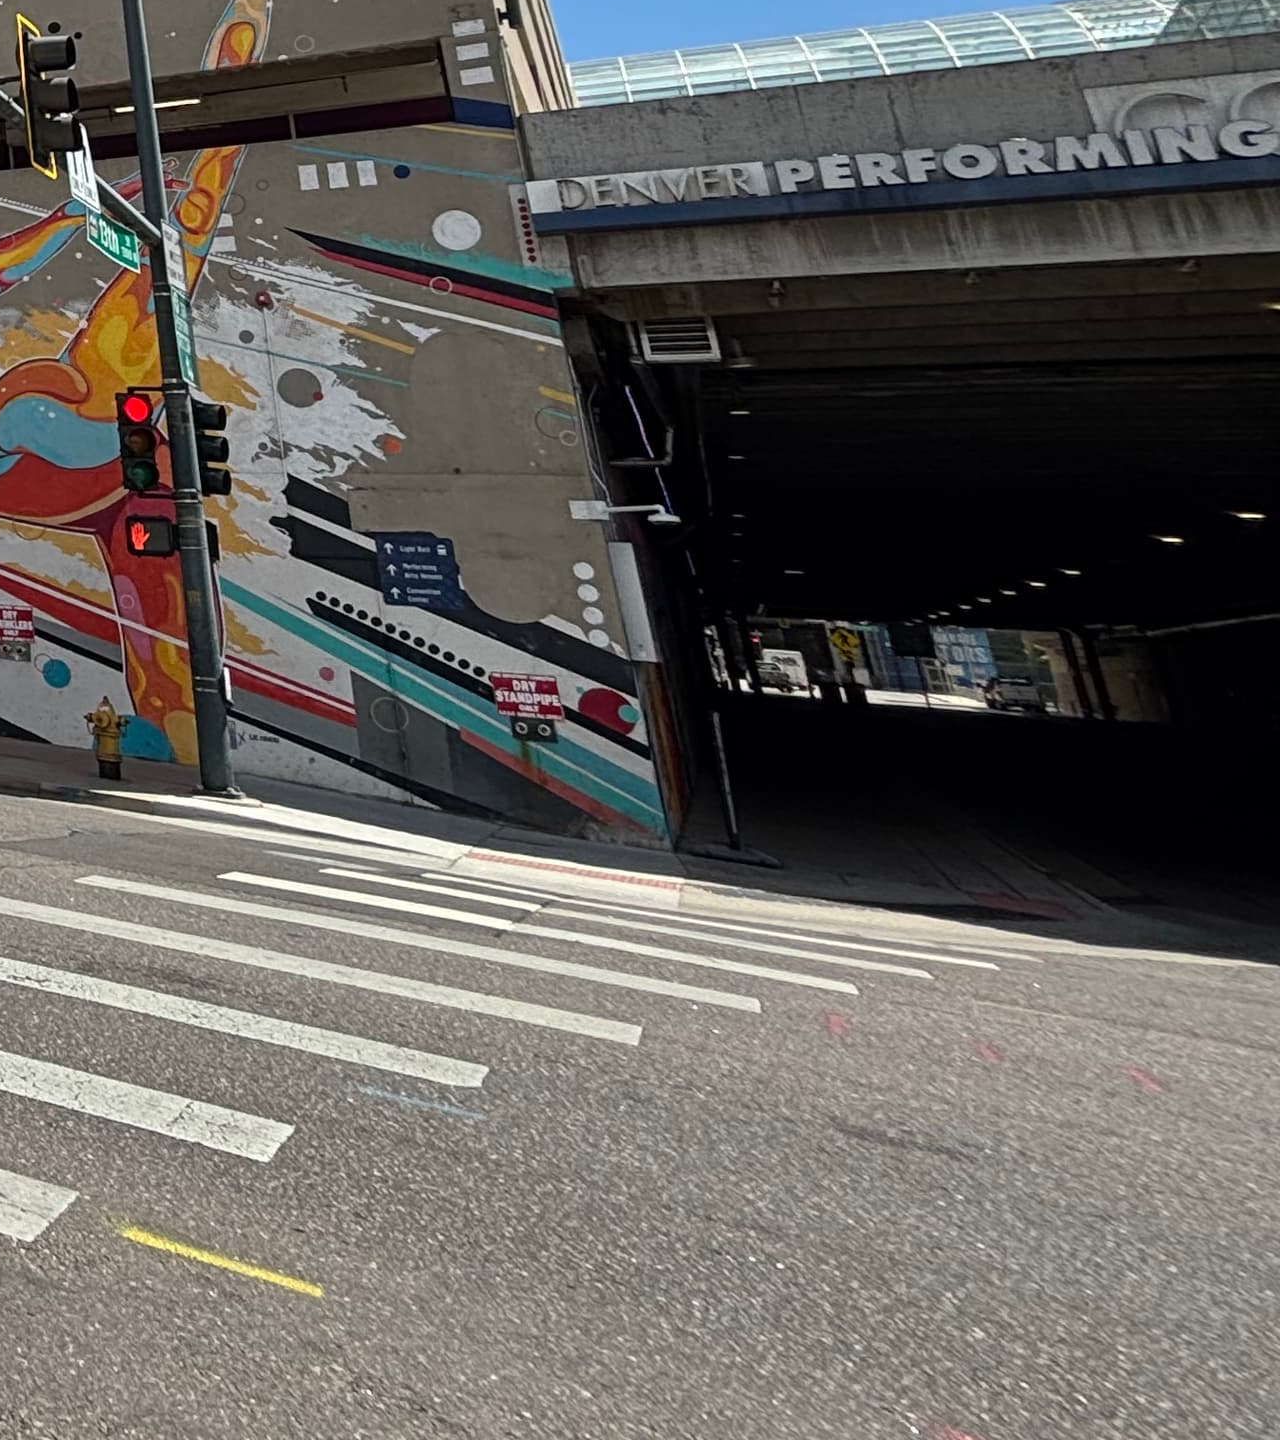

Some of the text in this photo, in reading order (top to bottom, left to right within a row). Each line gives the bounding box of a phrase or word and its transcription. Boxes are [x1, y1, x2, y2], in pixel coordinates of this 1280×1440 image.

[555, 118, 1279, 210] DENVER PERFORMING
[98, 217, 120, 256] 13th
[495, 689, 561, 707] STANDPIPE
[511, 679, 537, 692] DRY
